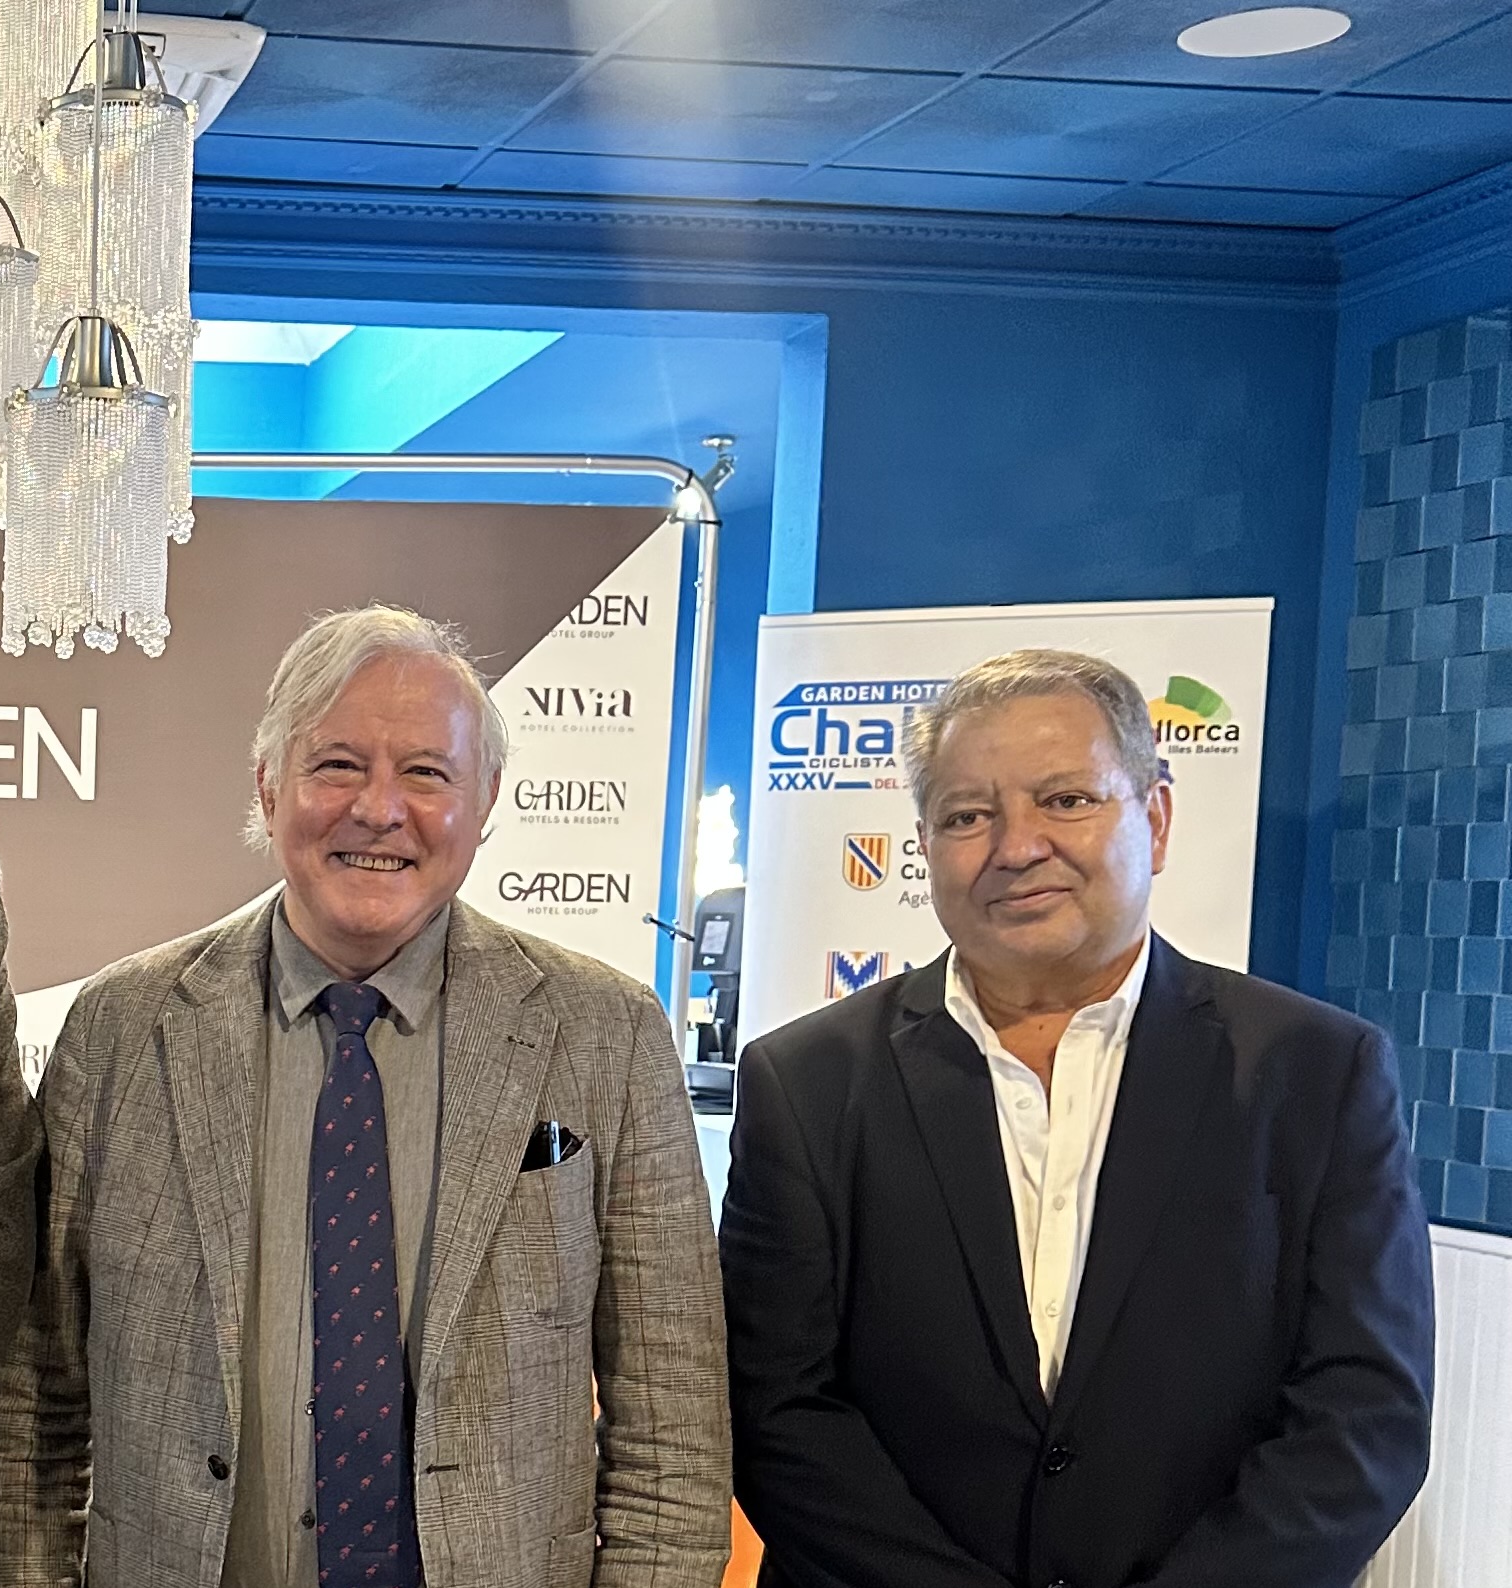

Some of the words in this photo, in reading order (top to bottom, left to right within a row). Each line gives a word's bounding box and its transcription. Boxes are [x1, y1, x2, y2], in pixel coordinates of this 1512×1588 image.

[548, 630, 576, 639] OTEL
[580, 630, 615, 639] GROUP
[800, 685, 885, 702] GARDEN
[892, 684, 947, 700] HOTE
[520, 725, 556, 733] HOTEL
[562, 725, 635, 733] COLLECTION
[1156, 719, 1240, 742] llorca
[1168, 745, 1192, 754] Illes
[1195, 744, 1239, 754] Balears
[809, 756, 897, 769] CICLISTA
[768, 772, 835, 791] XXXV
[874, 778, 899, 790] DEL
[514, 779, 627, 812] GARDEN
[520, 815, 560, 825] HOTELS
[574, 816, 620, 825] RESORTS
[499, 872, 631, 903] GARDEN
[527, 907, 560, 916] HOTEL
[564, 907, 598, 916] GROUP
